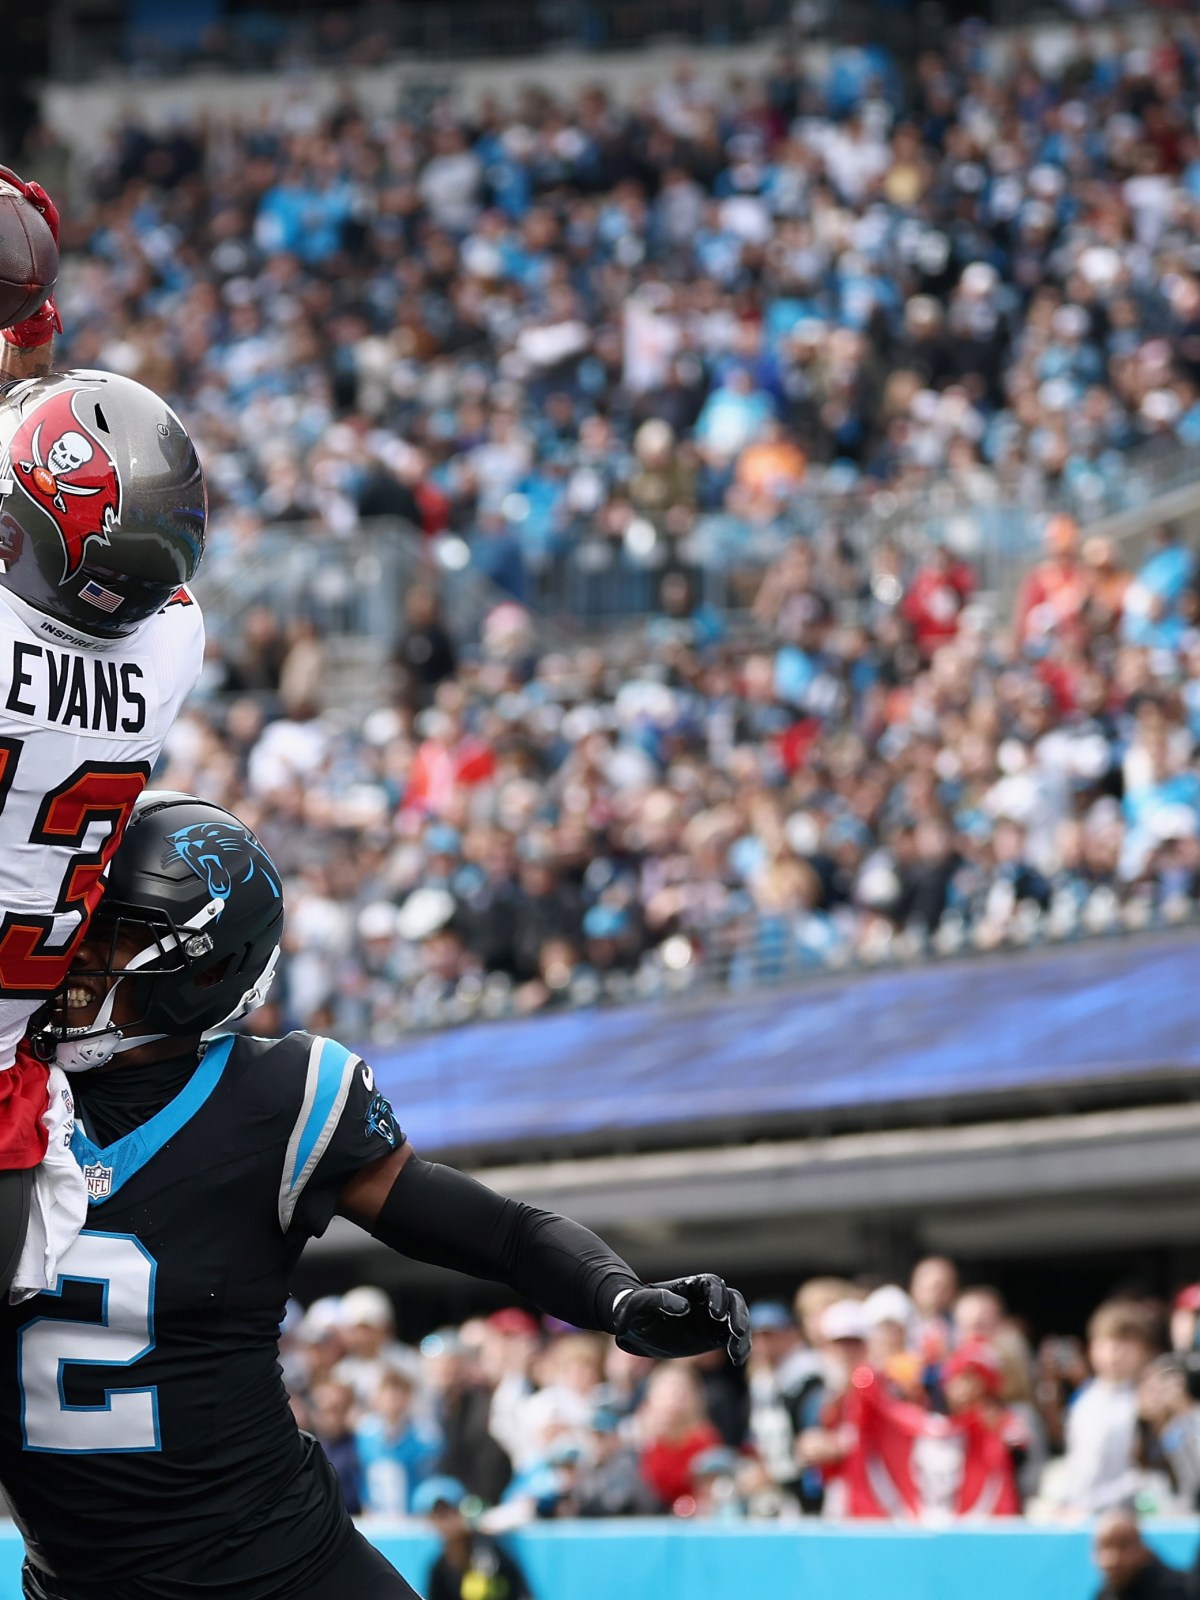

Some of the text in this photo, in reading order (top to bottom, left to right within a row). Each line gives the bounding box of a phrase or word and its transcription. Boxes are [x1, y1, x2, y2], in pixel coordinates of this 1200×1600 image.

[40, 621, 94, 649] INSPIRE
[5, 640, 146, 734] EVANS
[87, 1179, 107, 1194] NFL
[16, 1229, 162, 1454] 2
